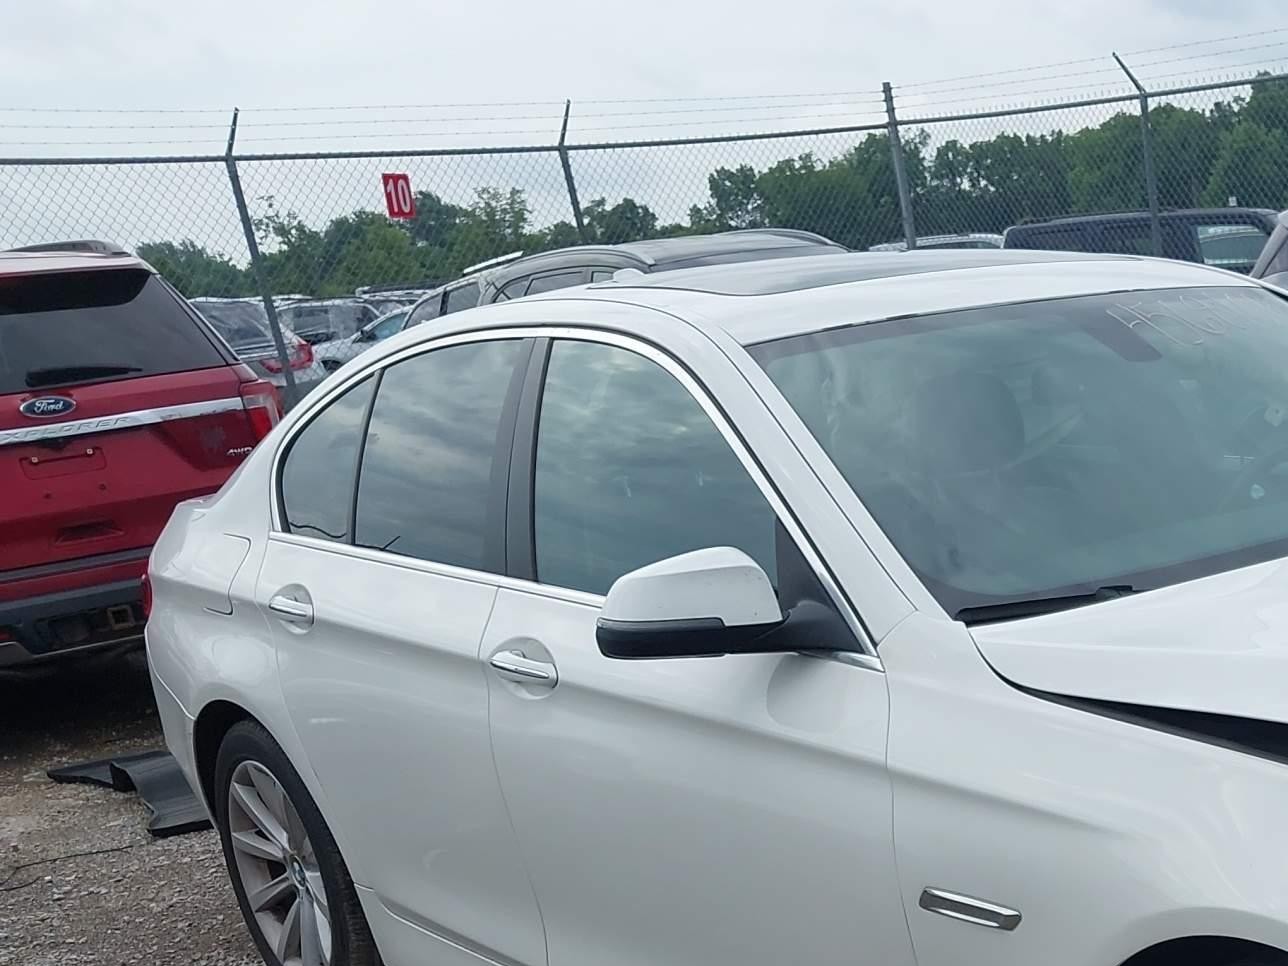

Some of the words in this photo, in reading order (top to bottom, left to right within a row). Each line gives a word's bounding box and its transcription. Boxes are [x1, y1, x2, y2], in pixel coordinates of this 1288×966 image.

[387, 178, 411, 213] 10
[33, 399, 65, 414] Ford
[2, 416, 129, 441] XPLORER
